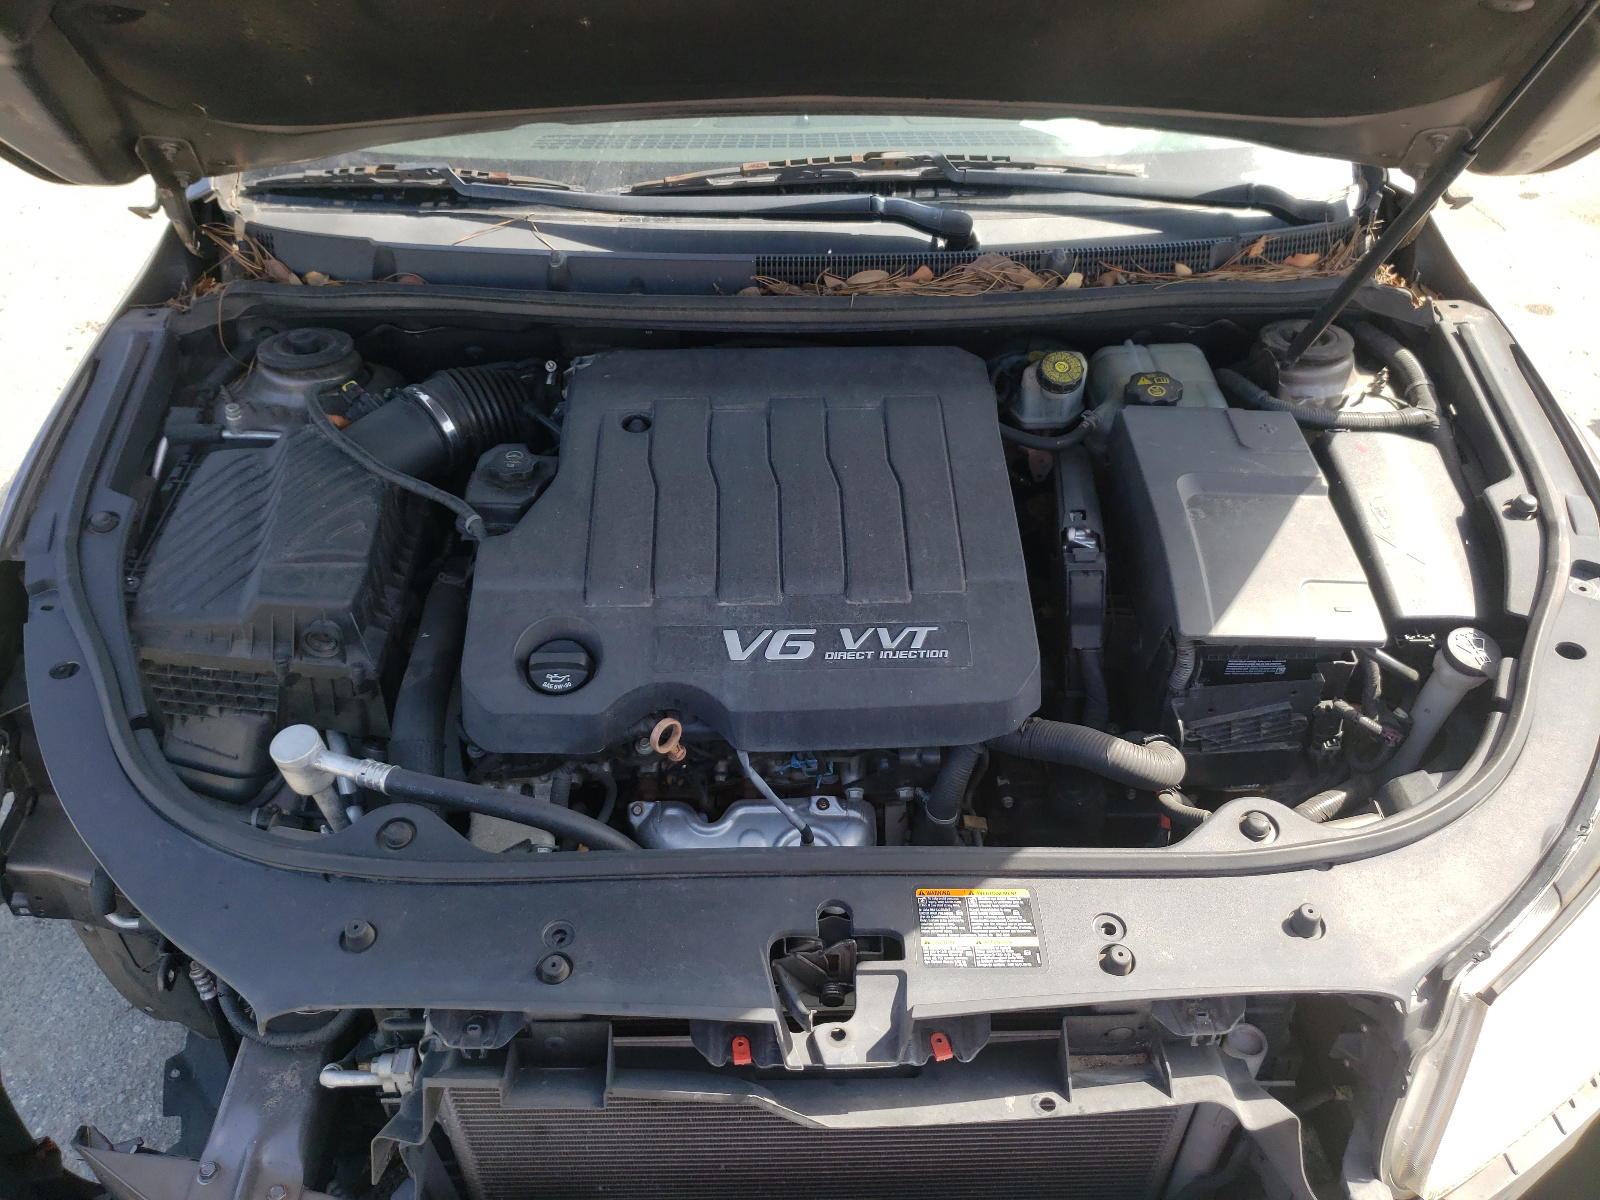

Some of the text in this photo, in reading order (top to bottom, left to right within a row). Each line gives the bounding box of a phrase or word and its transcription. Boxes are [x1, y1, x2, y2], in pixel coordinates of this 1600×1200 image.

[723, 627, 939, 661] V6 VVT
[824, 650, 949, 660] DIRECT INJECTION
